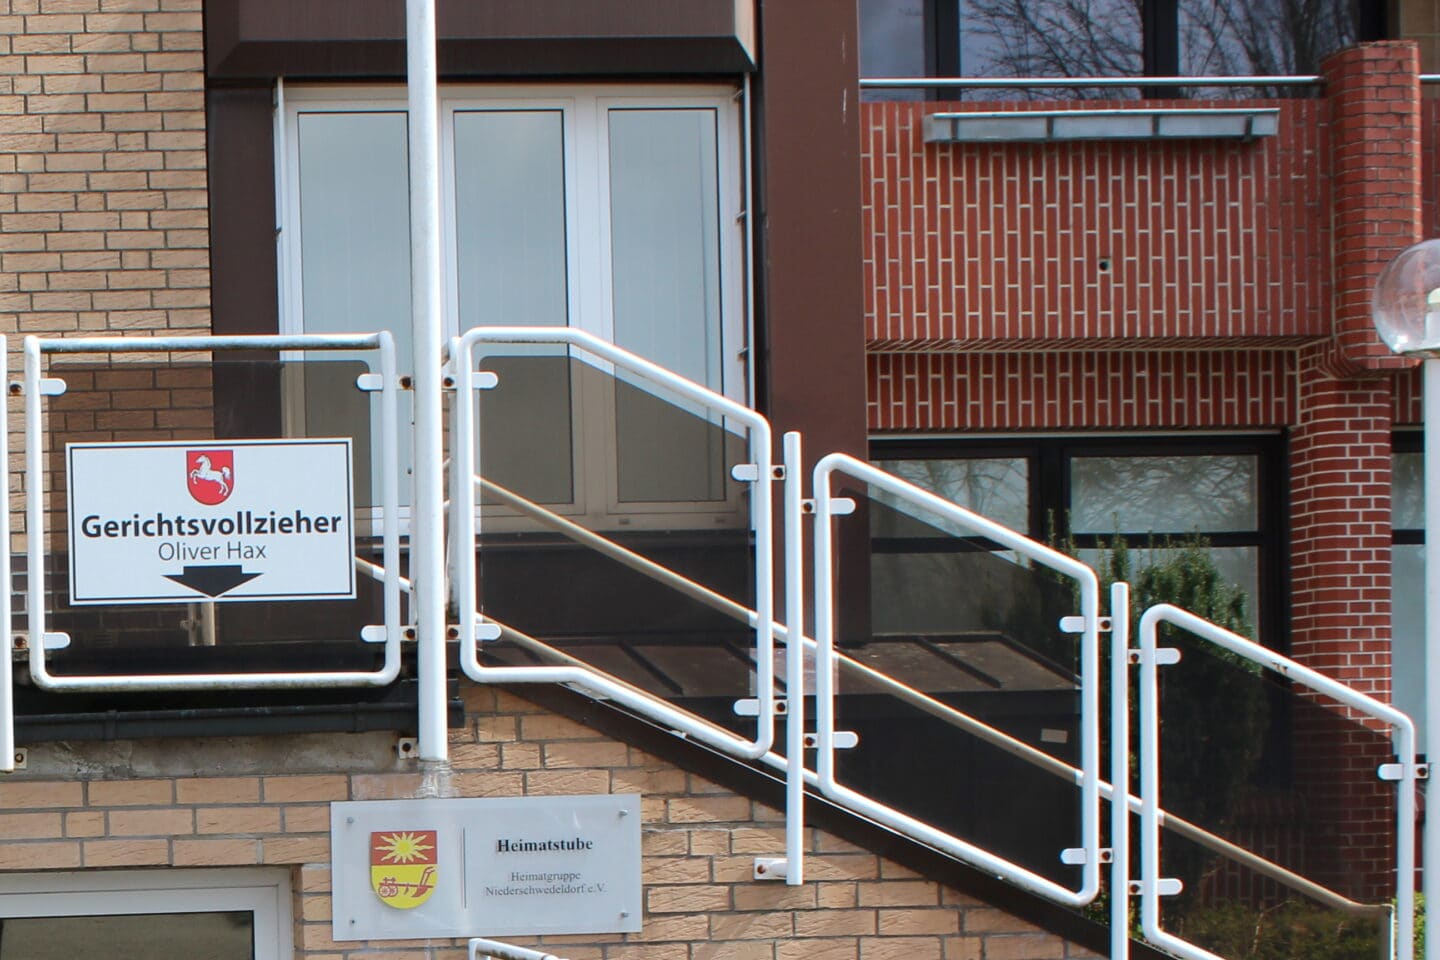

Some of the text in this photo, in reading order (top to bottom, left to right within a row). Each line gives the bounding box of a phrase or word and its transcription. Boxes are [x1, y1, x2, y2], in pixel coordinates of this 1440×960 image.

[81, 510, 342, 538] Gerichtsvollzieher
[158, 541, 266, 561] Oliver Hax
[497, 837, 593, 852] Heimatstube
[511, 871, 581, 883] Heimatgruppe
[485, 883, 585, 896] Niederschwedeldorf
